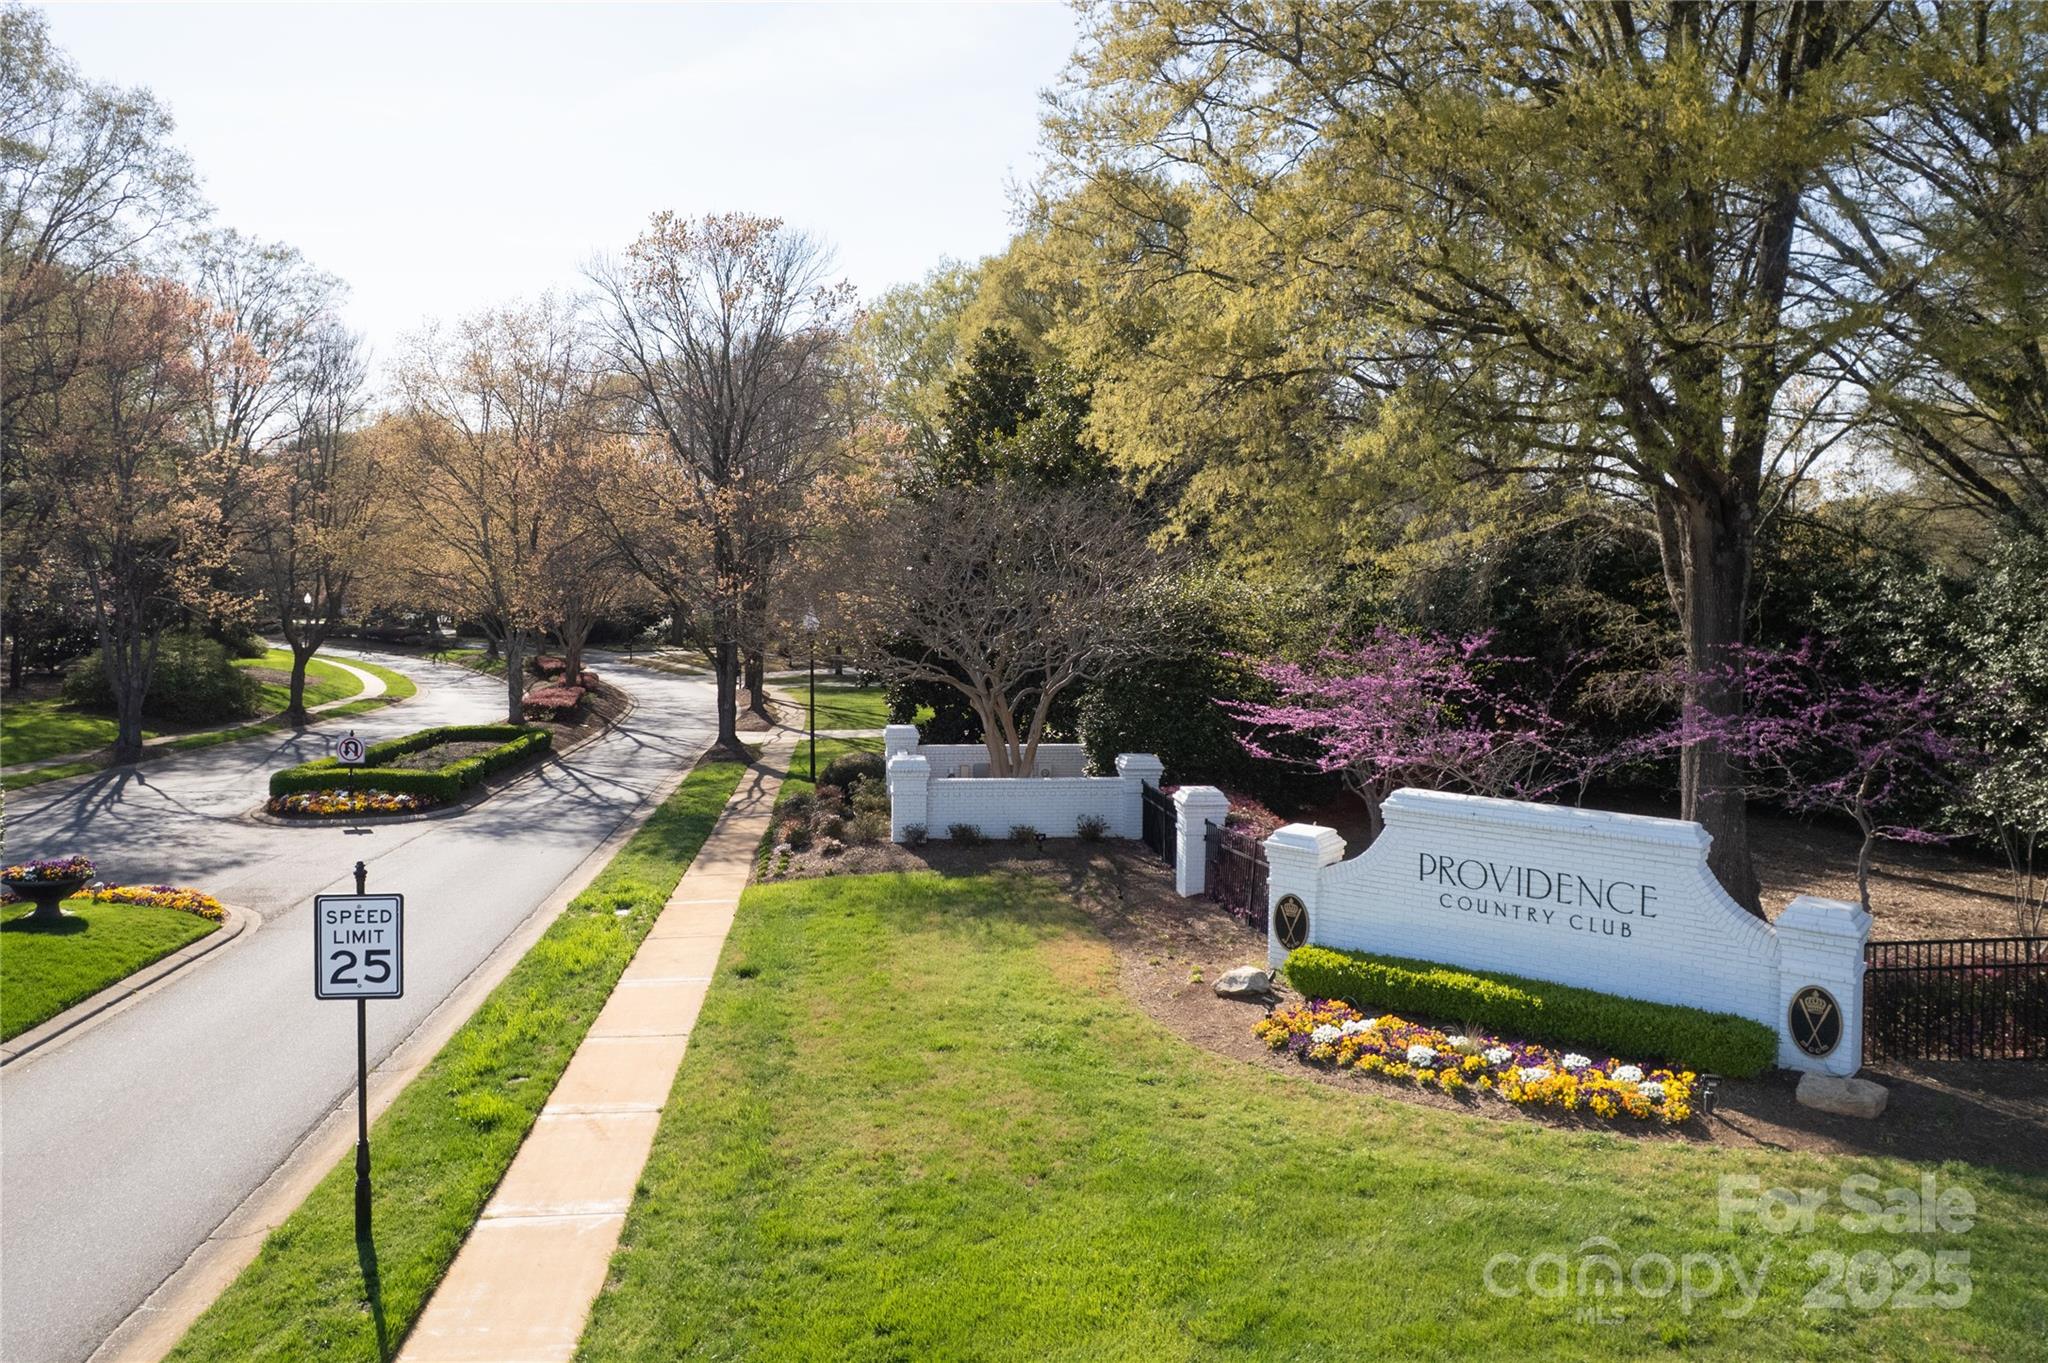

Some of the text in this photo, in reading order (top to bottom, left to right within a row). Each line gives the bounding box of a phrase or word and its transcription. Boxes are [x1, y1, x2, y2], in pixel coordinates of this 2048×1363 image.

[1419, 852, 1658, 918] PROVIDENCE
[326, 910, 392, 924] SPEED
[1439, 893, 1632, 938] COUNTRY CLUB
[333, 930, 384, 944] LIMIT
[330, 949, 391, 984] 25
